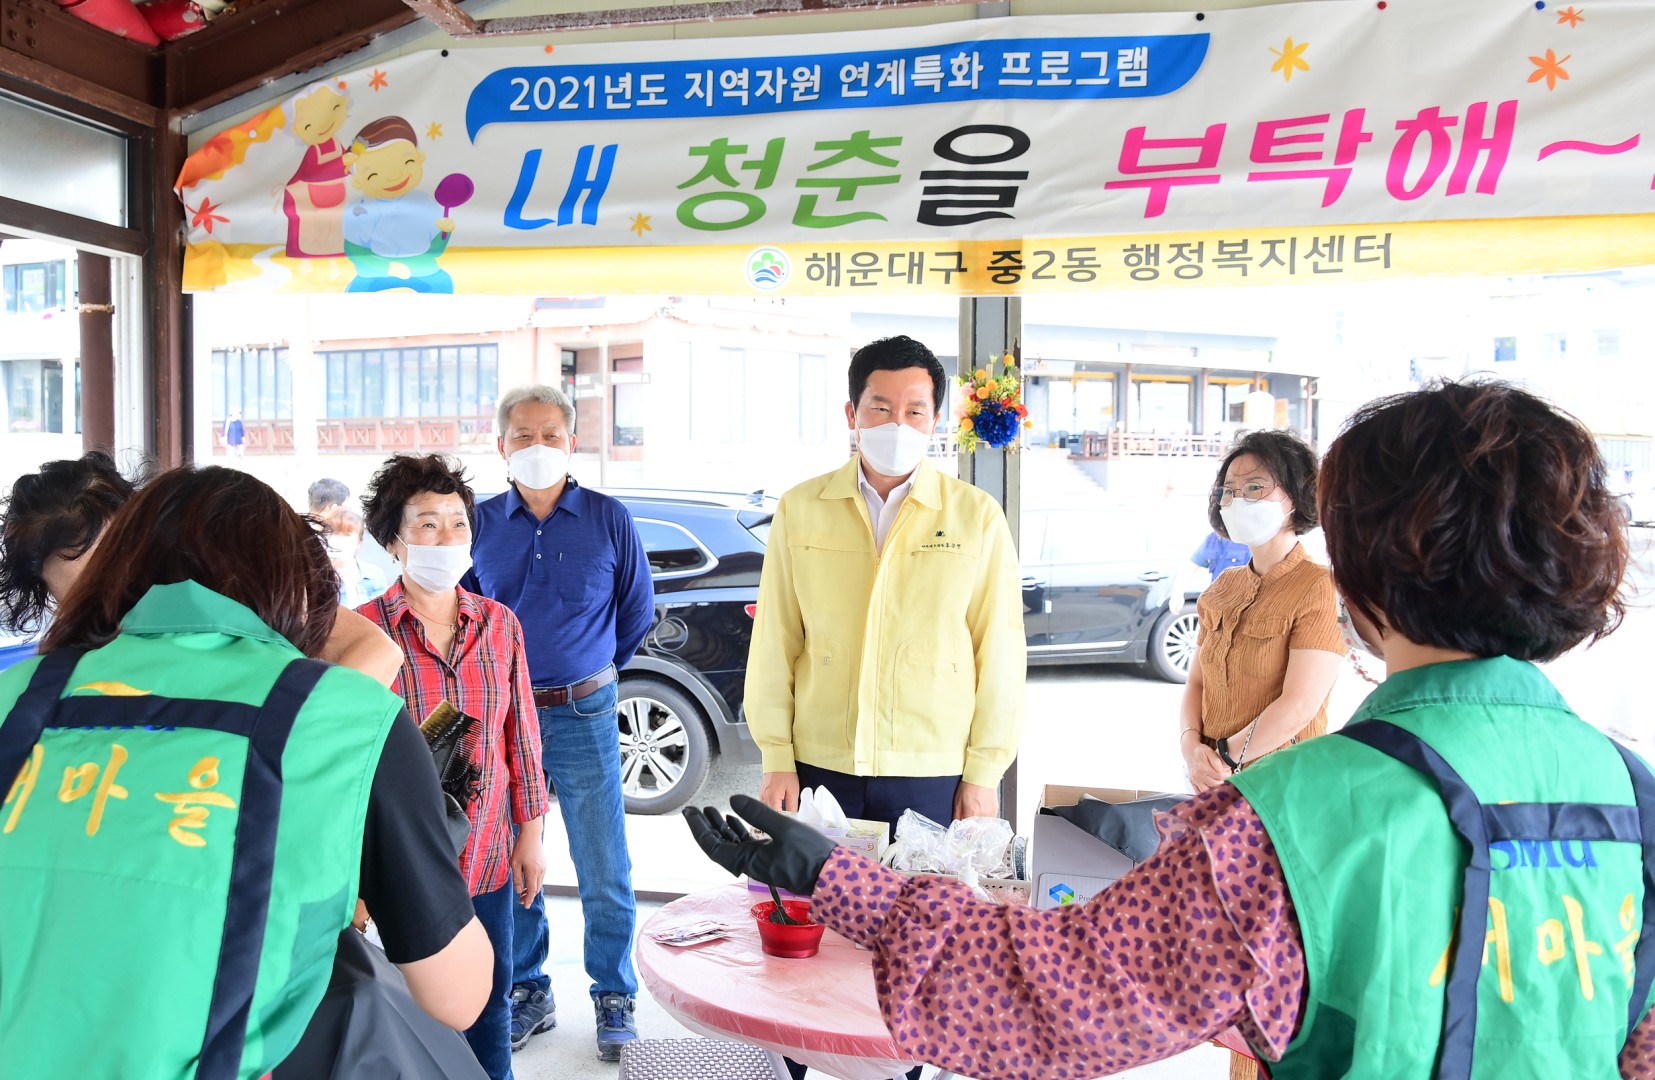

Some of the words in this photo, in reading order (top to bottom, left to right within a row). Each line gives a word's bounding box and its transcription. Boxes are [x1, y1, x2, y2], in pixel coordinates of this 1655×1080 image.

[508, 72, 669, 111] 2021년도
[683, 64, 822, 107] 지역자원
[838, 51, 984, 98] 연계특화
[998, 46, 1149, 88] 프로그램
[503, 144, 619, 230] 내
[676, 124, 1031, 231] 청춘을
[805, 251, 968, 287] 해운대구
[987, 247, 1101, 285] 중2동
[1122, 233, 1393, 282] 행정복지센터
